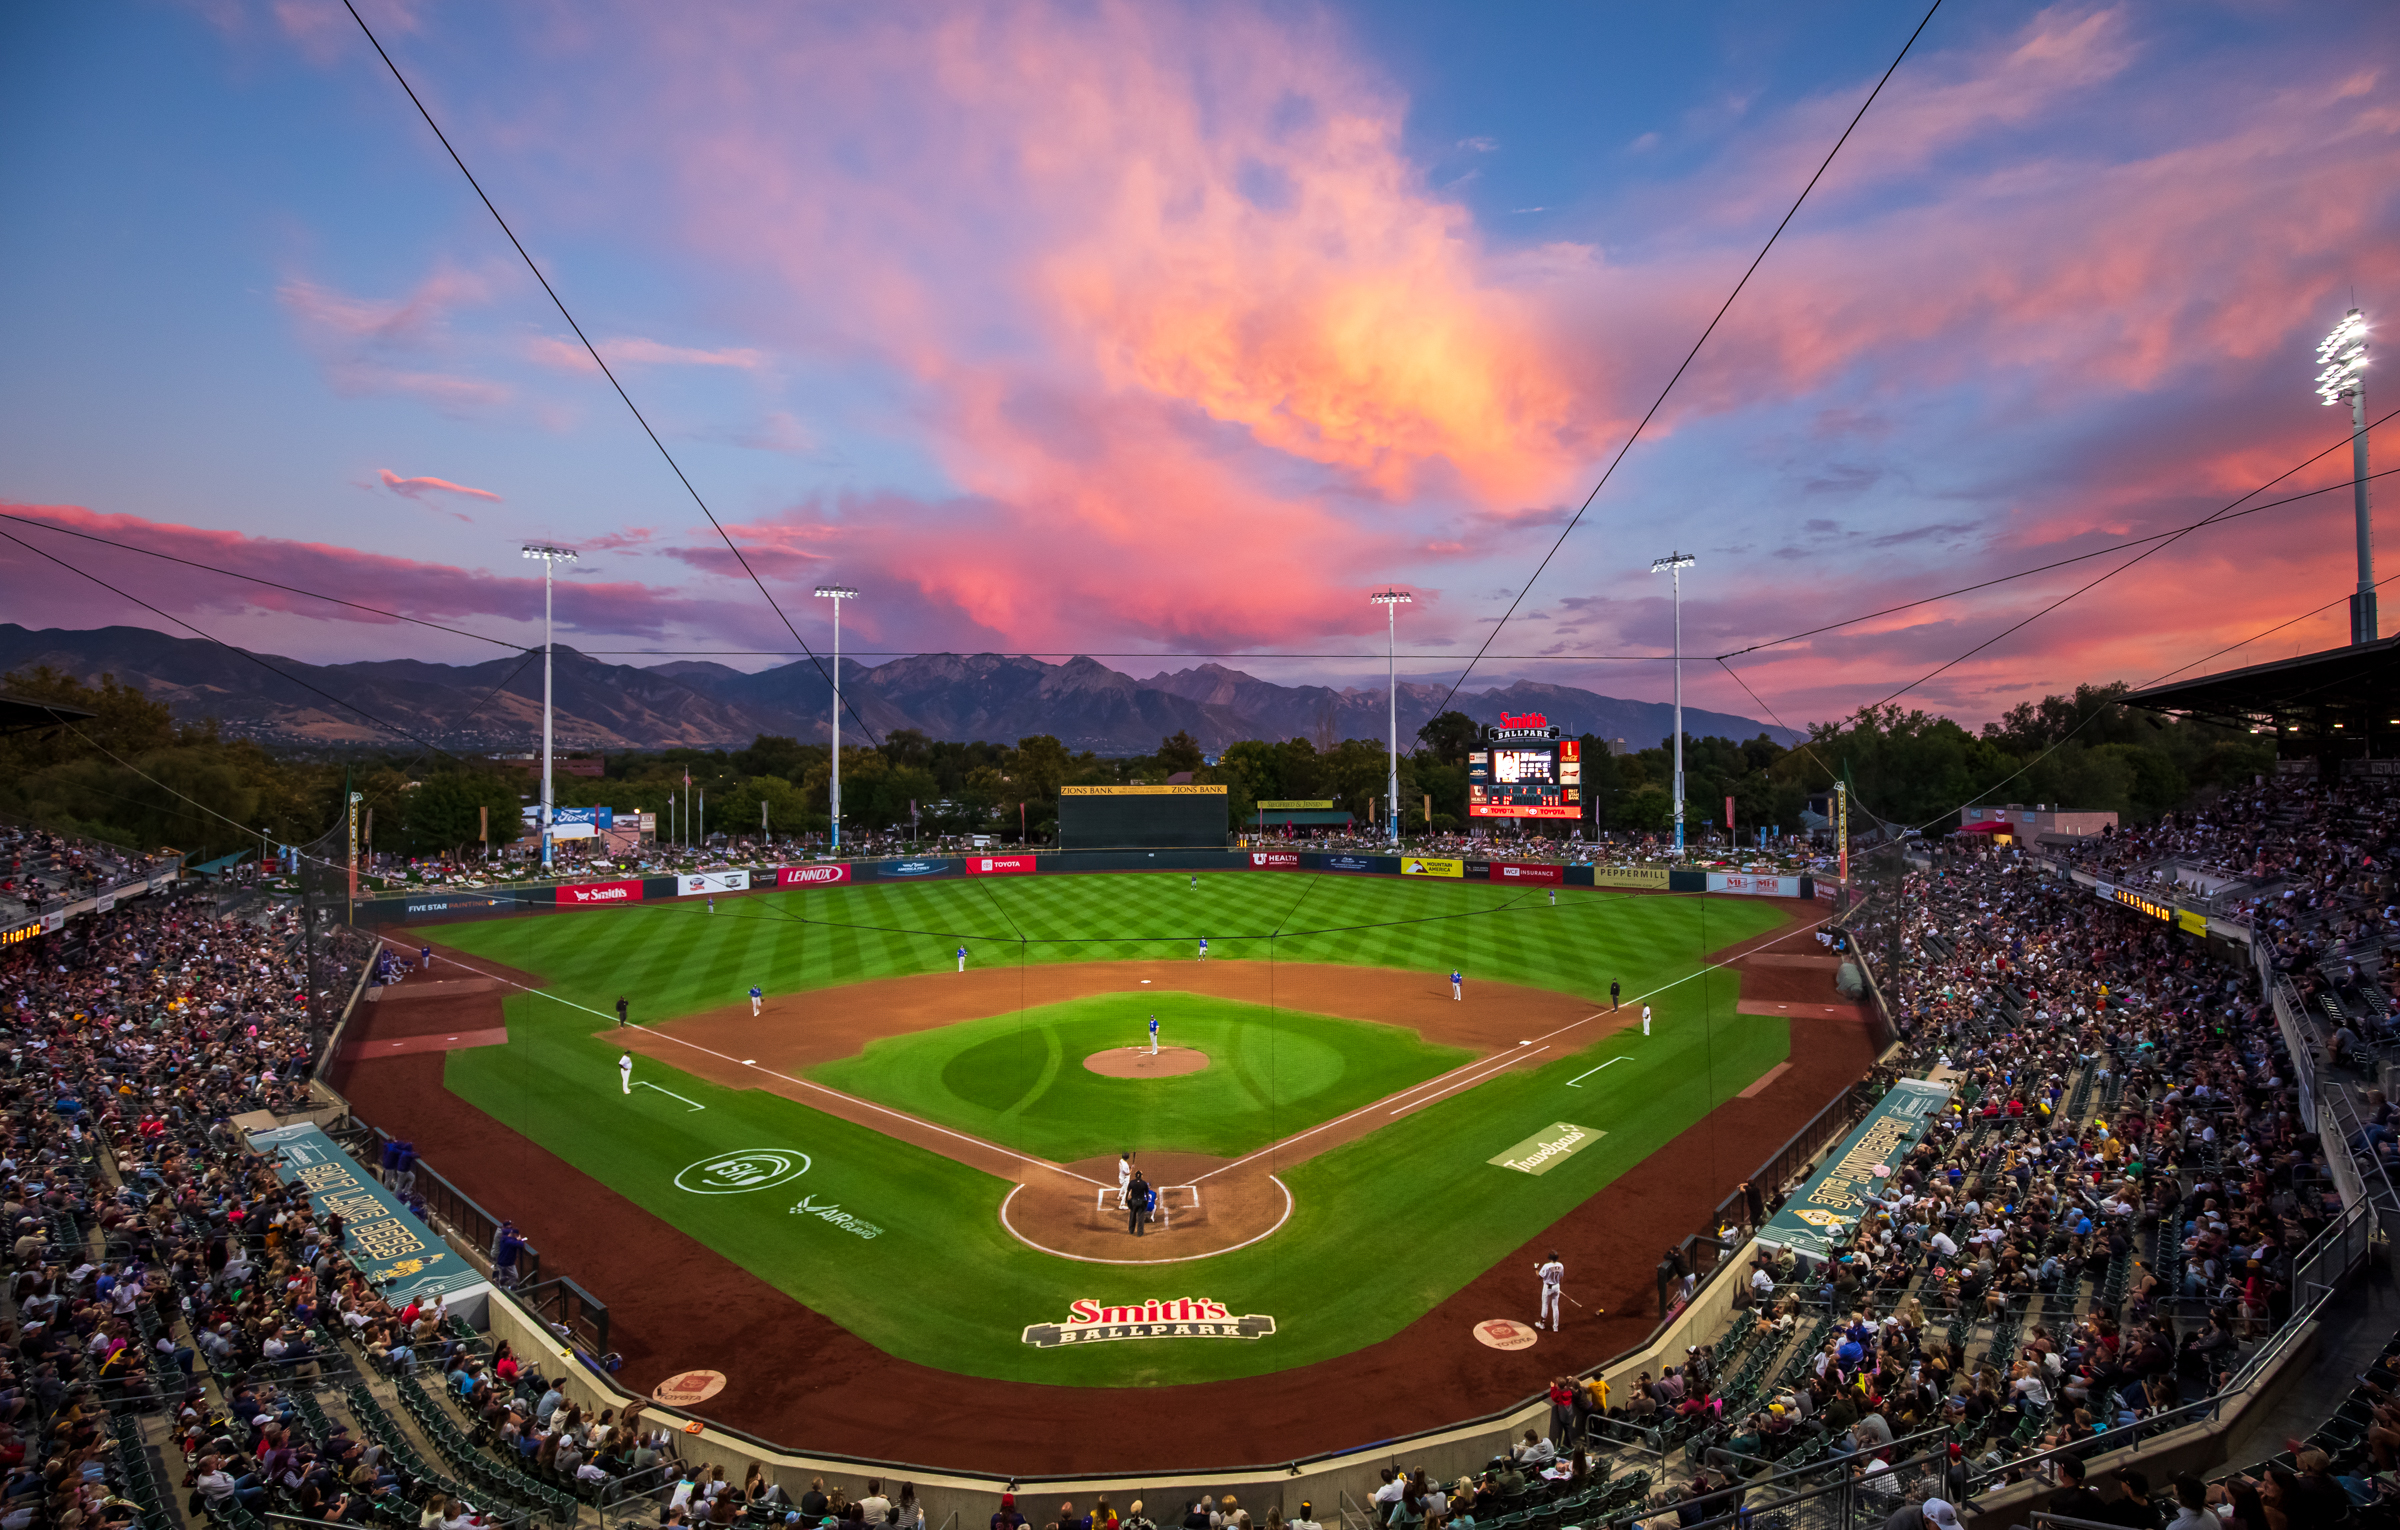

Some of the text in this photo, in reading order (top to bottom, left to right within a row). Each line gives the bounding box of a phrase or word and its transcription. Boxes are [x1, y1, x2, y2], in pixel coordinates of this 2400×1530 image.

[1500, 712, 1547, 729] Smith's
[1498, 730, 1550, 739] BALLPARK
[558, 809, 589, 822] Ford
[787, 868, 832, 883] LENNOX
[1600, 869, 1665, 879] PEPPERMILL
[590, 887, 627, 900] Smith's
[428, 903, 447, 911] STAR
[448, 900, 487, 909] PAINTING
[1831, 1116, 1914, 1184] ANNIVERSARY
[296, 1163, 359, 1192] SALT
[320, 1187, 390, 1224] LAKE
[815, 1209, 853, 1226] AIR
[350, 1218, 425, 1260] BEES
[840, 1222, 877, 1240] GUARD
[1070, 1298, 1226, 1324] Smith's
[1059, 1324, 1241, 1344] BALLPARK
[1495, 1337, 1532, 1348] TOYOTA
